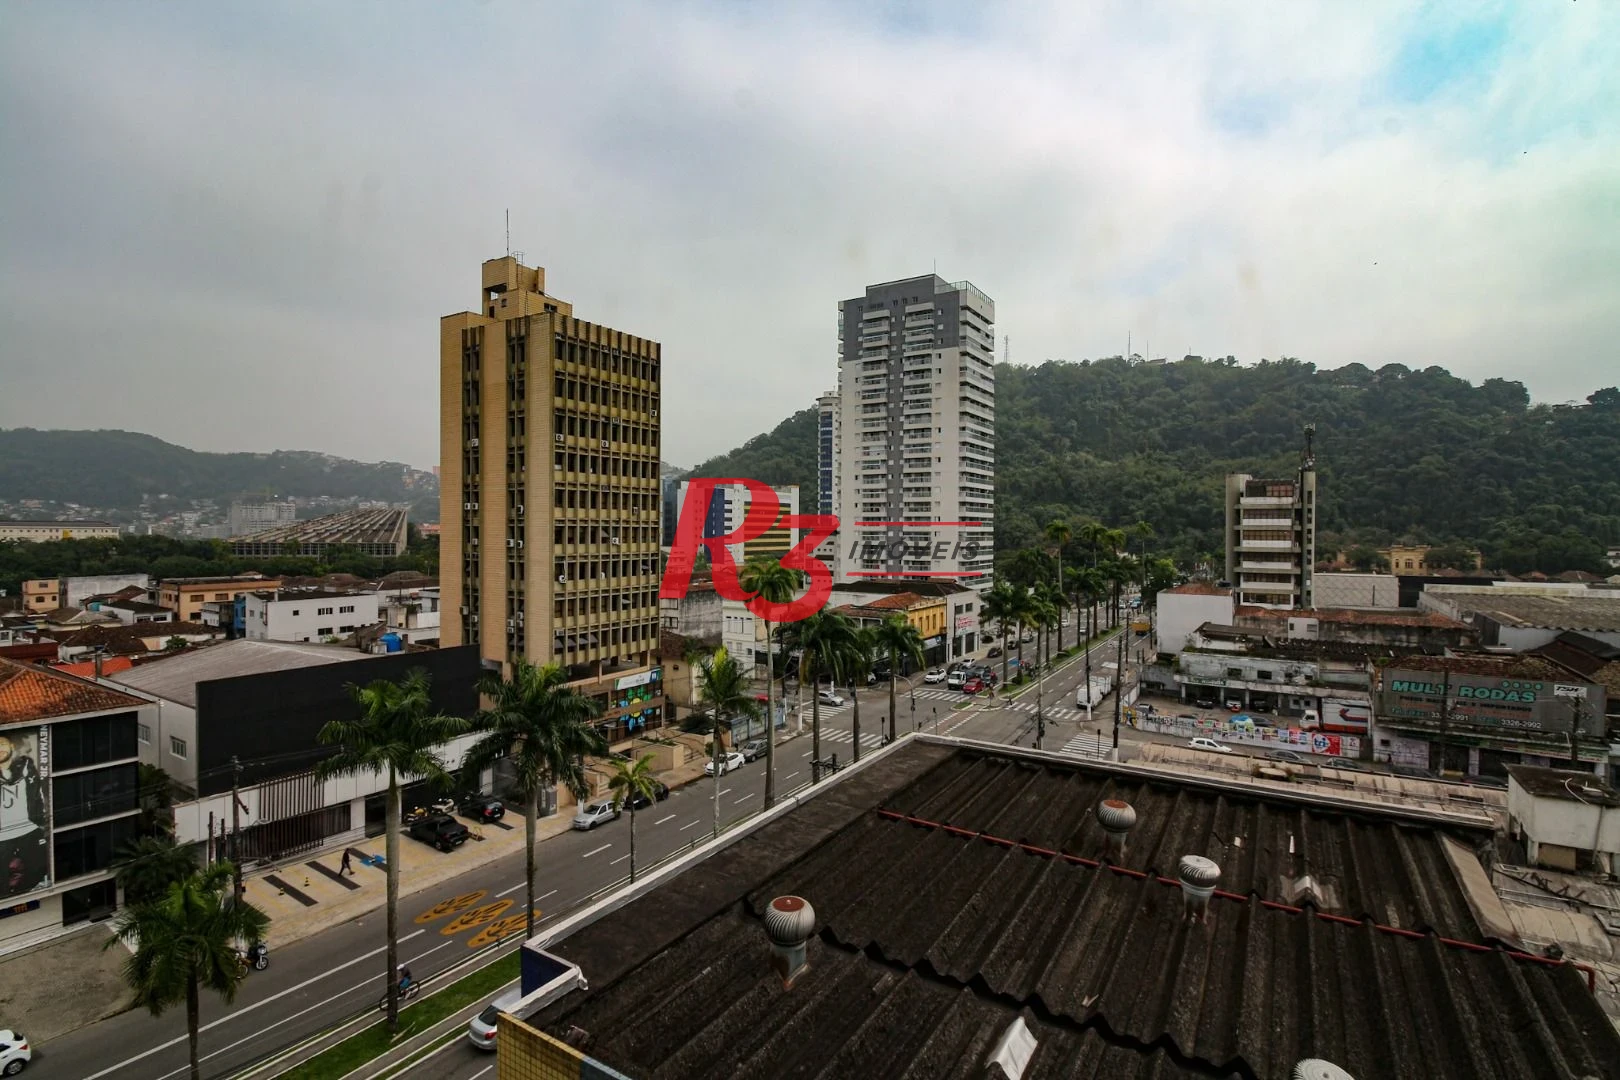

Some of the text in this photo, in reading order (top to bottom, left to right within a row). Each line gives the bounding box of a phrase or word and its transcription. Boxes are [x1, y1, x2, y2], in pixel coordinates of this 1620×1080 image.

[1458, 685, 1537, 704] RODAS
[40, 725, 48, 780] NEYMAR JR.
